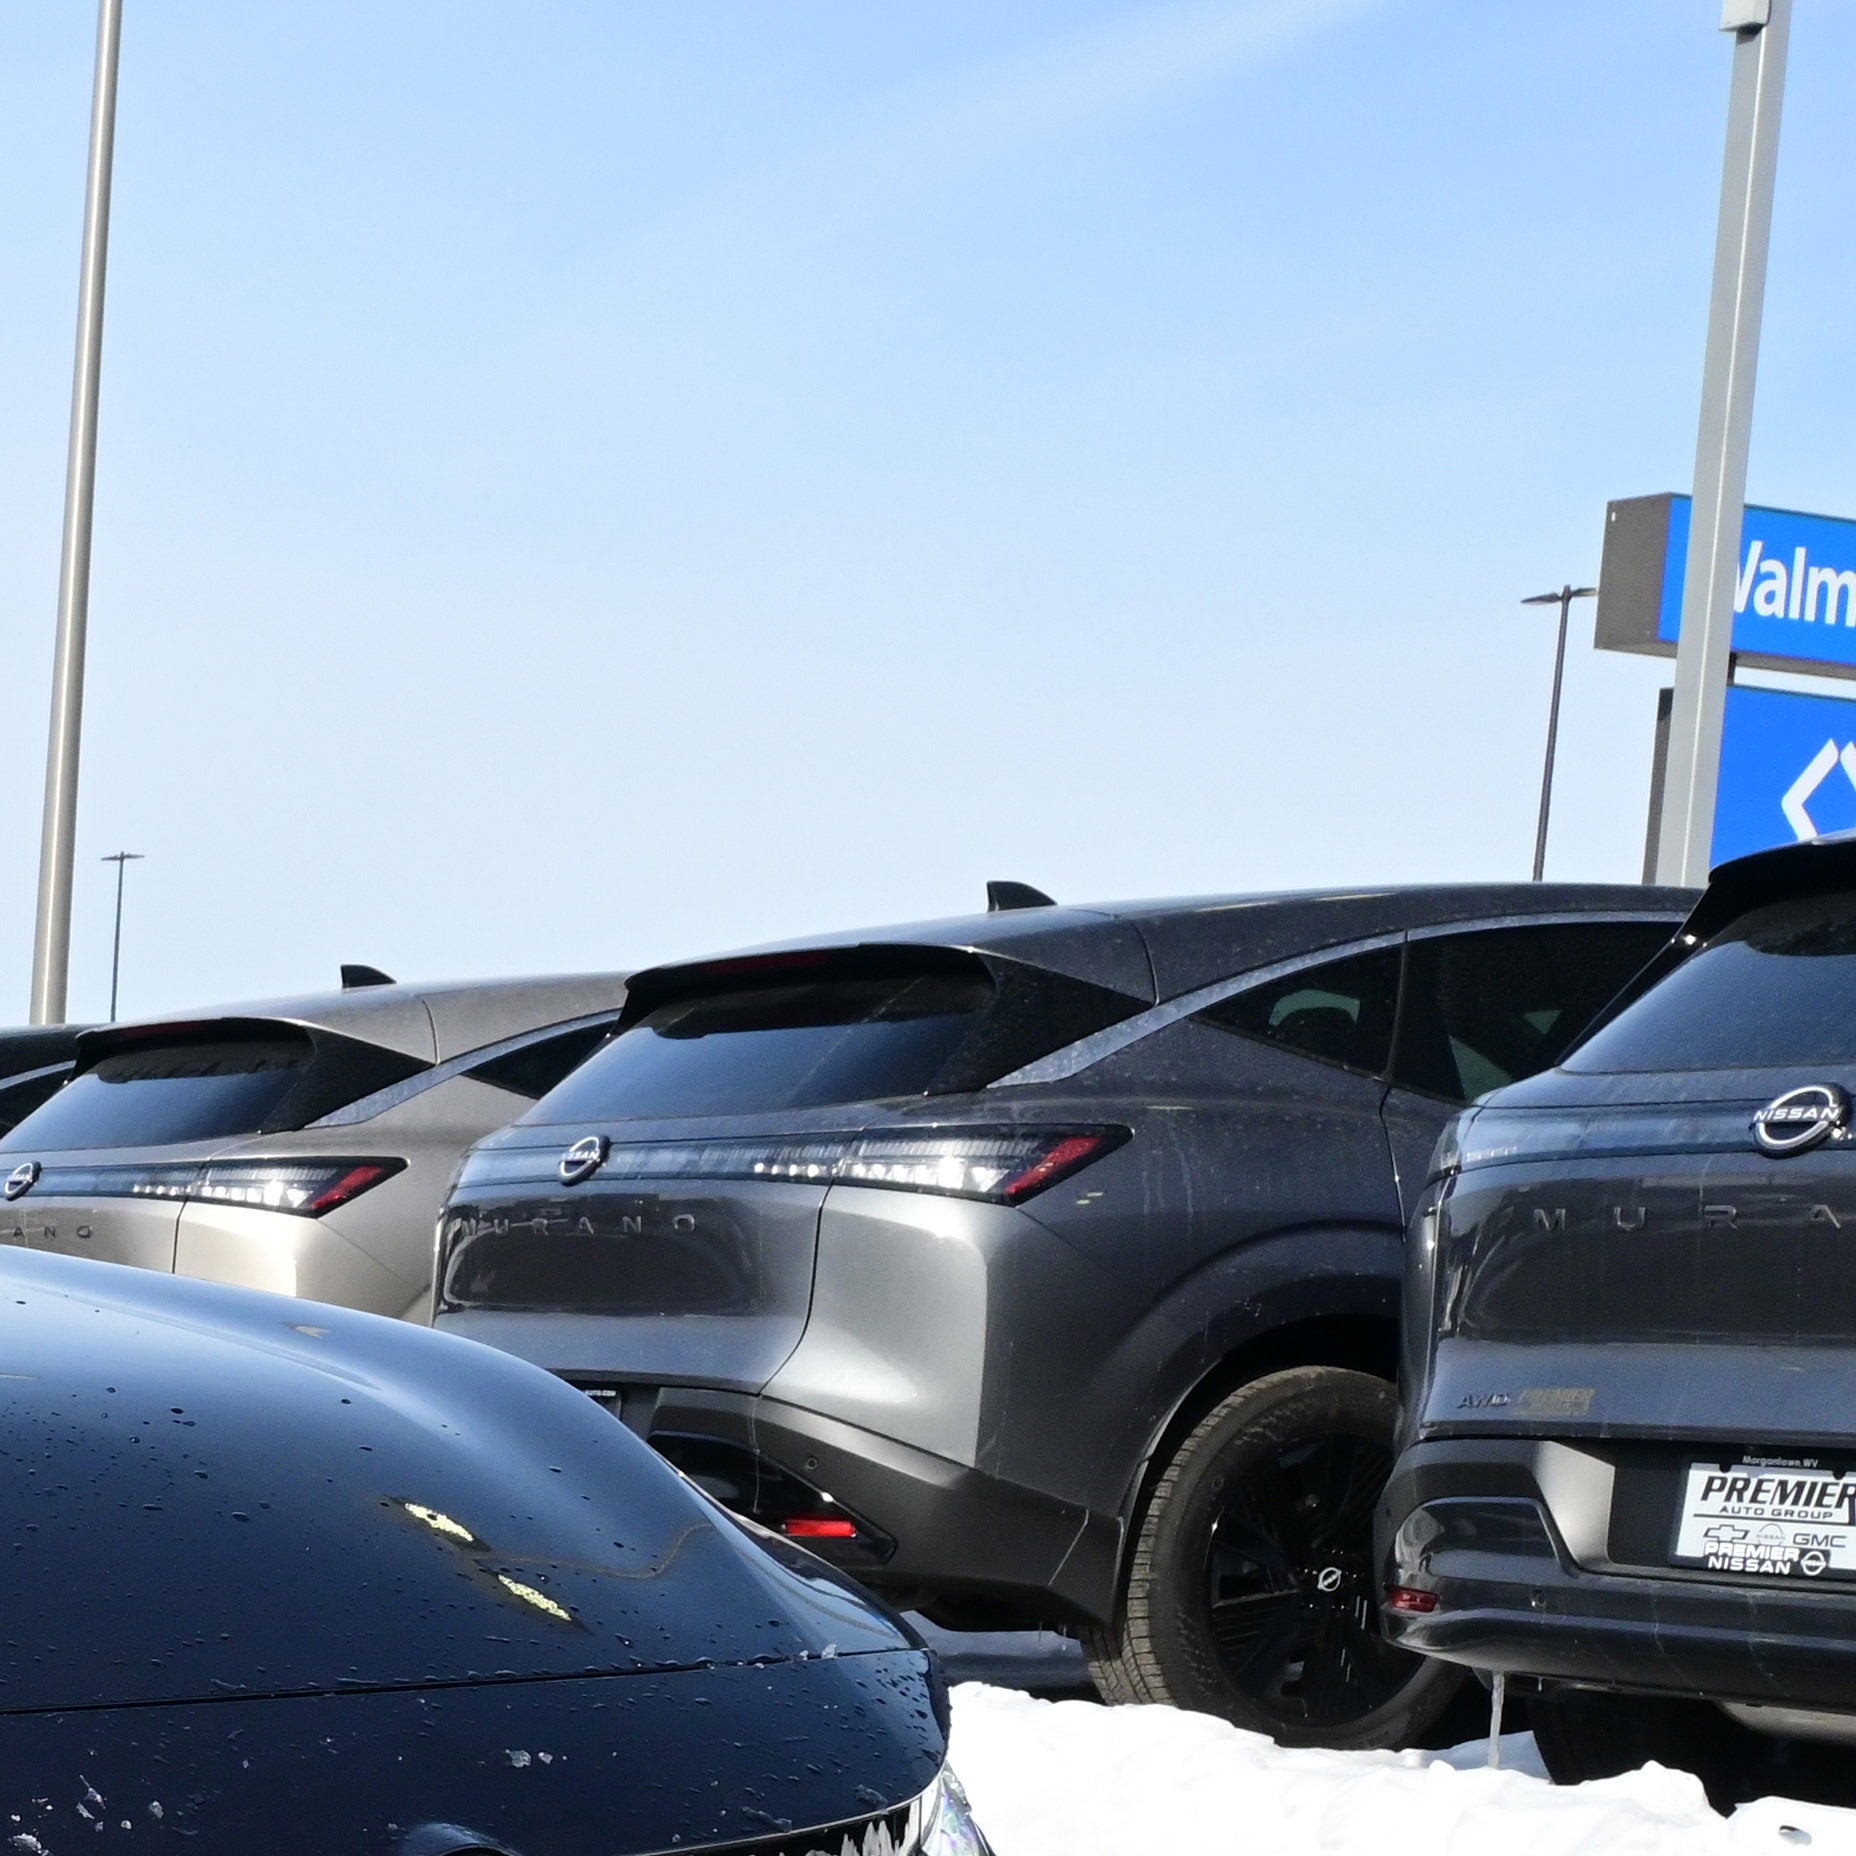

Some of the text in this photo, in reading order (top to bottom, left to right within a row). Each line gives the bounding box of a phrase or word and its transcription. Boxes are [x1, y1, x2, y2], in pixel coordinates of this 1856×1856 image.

[1754, 1107, 1840, 1121] NISSAN
[1534, 1204, 1841, 1231] MURA
[1803, 1458, 1819, 1468] WV
[1700, 1475, 1856, 1510] PREMIER
[1719, 1505, 1833, 1520] AUTO GROUP
[1792, 1532, 1847, 1548] GMC
[1705, 1541, 1800, 1562] PREMIER
[1708, 1556, 1791, 1575] NISSAN
